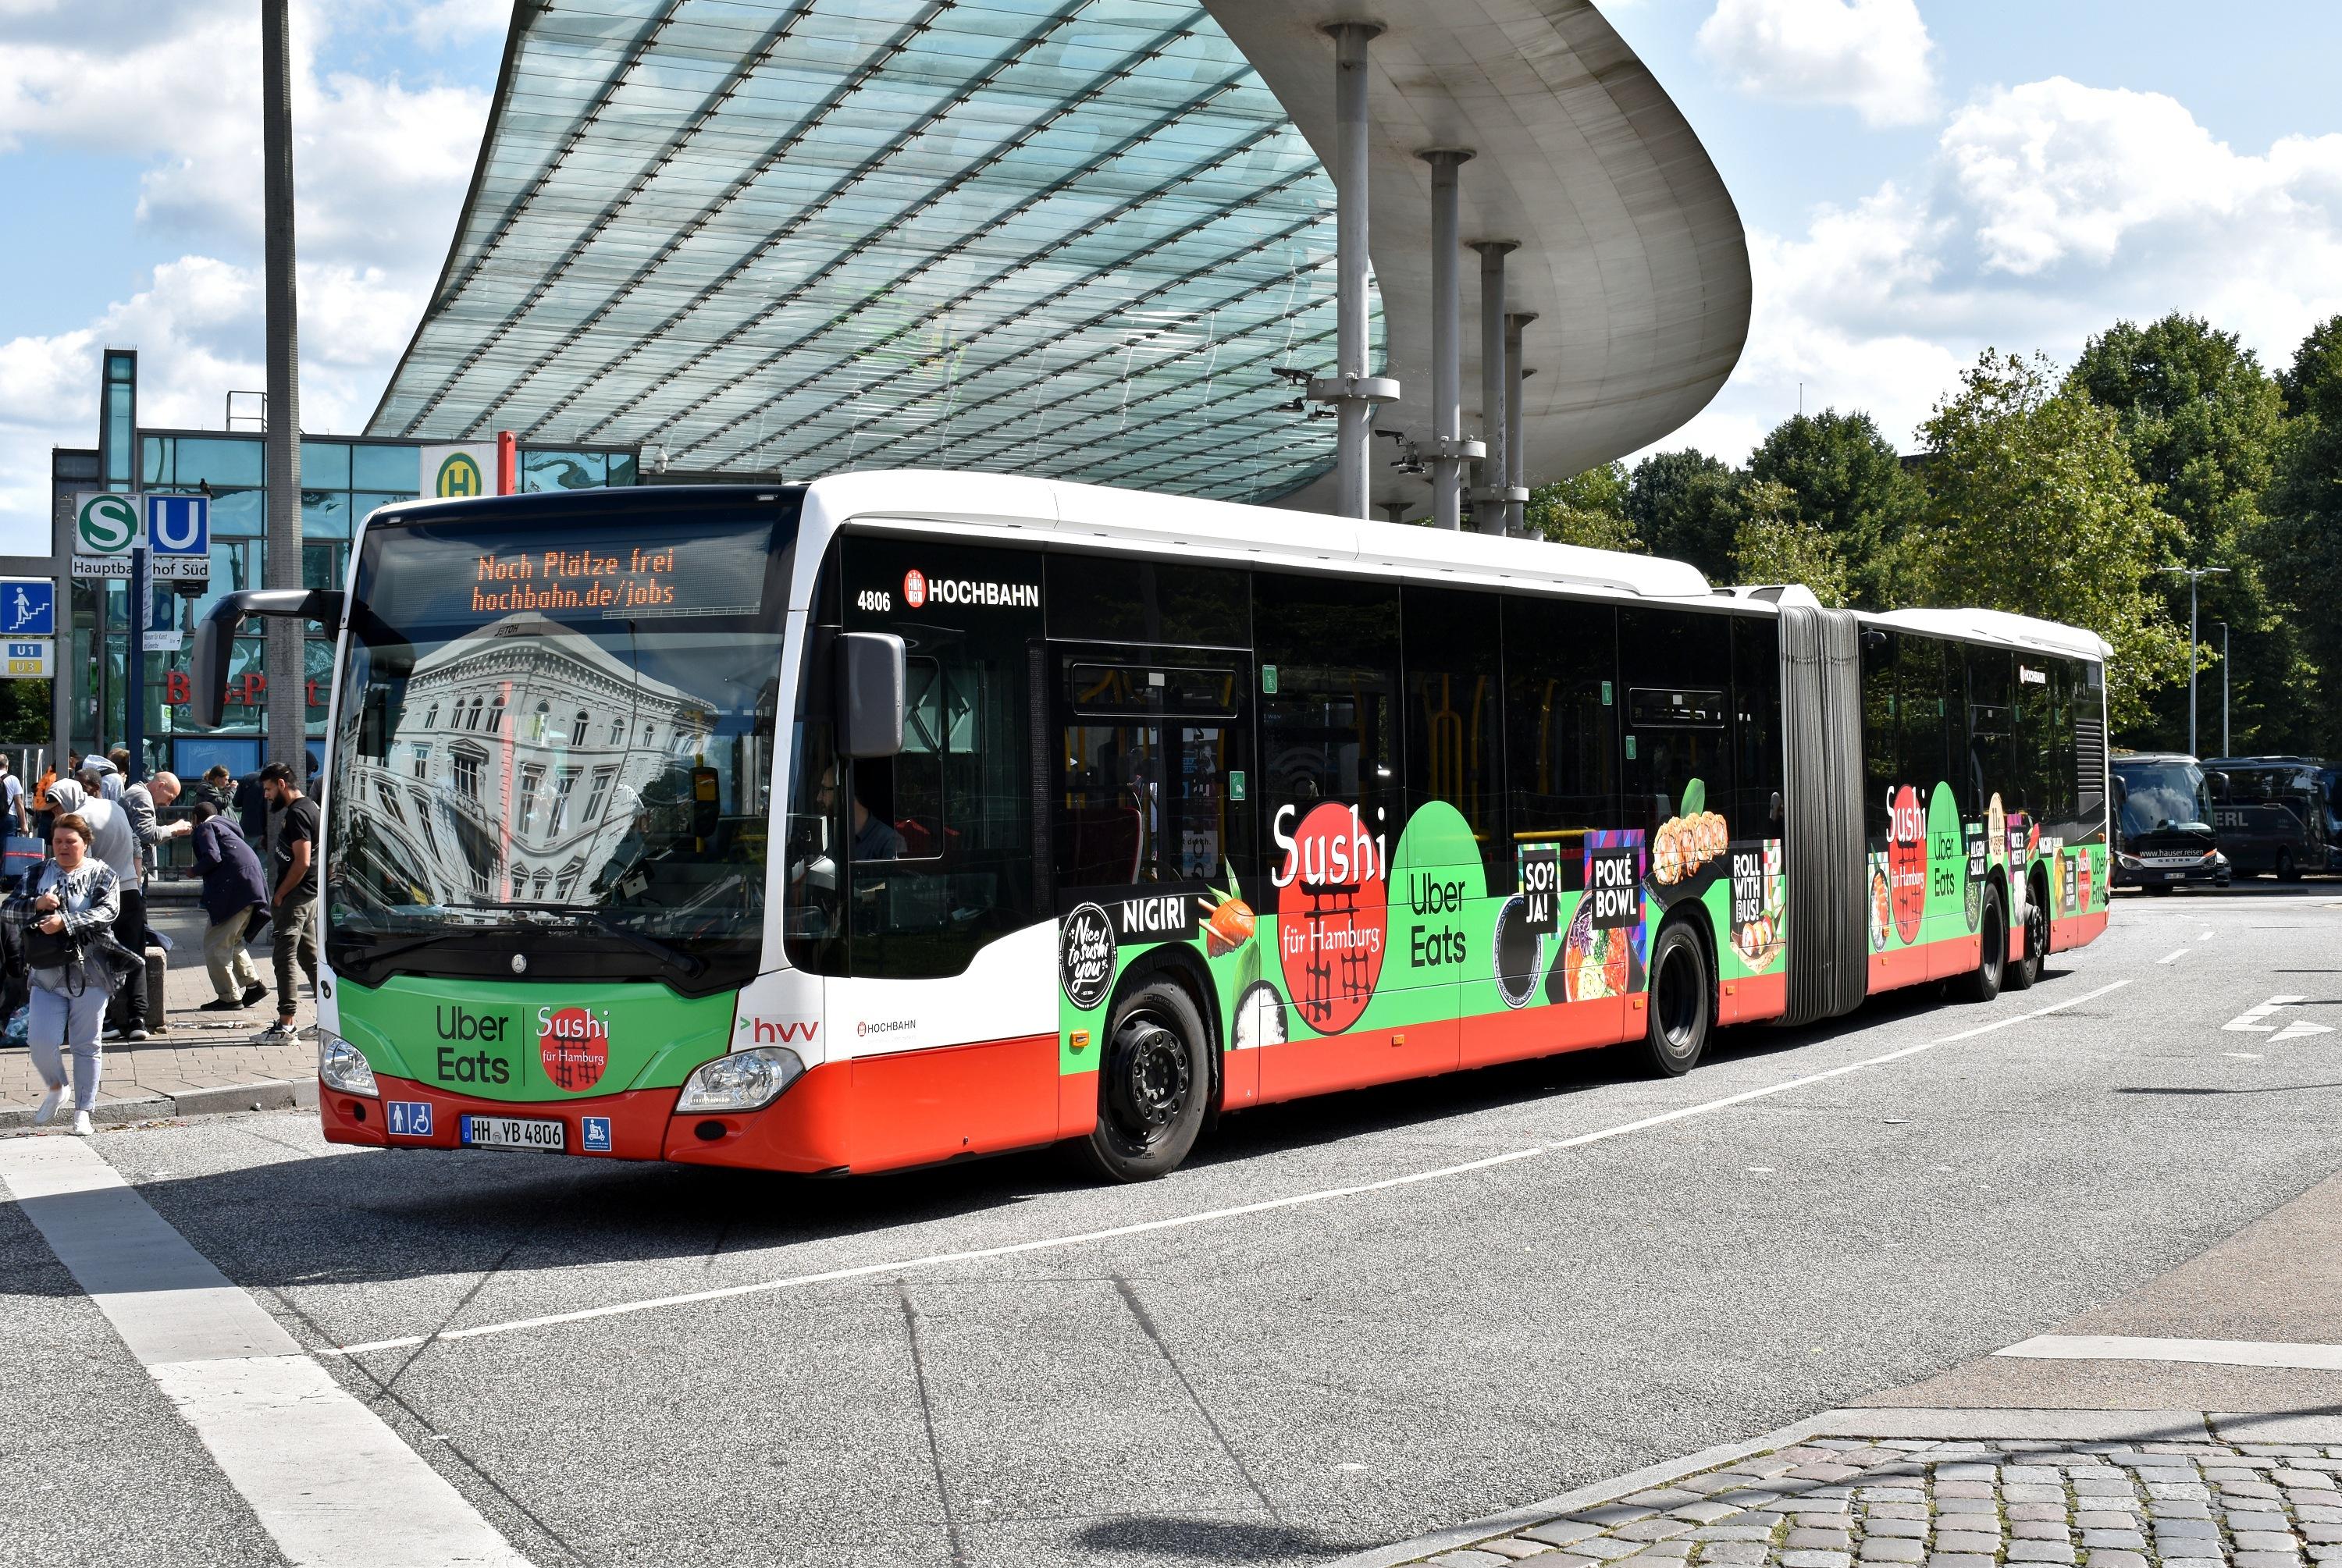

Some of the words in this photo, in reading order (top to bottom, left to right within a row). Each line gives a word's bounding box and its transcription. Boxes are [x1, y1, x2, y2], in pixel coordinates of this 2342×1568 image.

[89, 500, 129, 547] S
[157, 501, 199, 549] U
[74, 562, 175, 576] Hauptbahof
[182, 564, 208, 576] Süd
[478, 554, 532, 580] Noch
[544, 550, 618, 578] Plätze
[631, 548, 674, 574] frei
[472, 578, 674, 611] hochbahn.de/jobs
[858, 590, 891, 612] 4806
[928, 579, 1039, 606] HOCHBAHN
[1886, 785, 1926, 843] Sushi
[1271, 803, 1386, 887] Sushi
[1934, 831, 1954, 861] Uber
[1970, 841, 1985, 858] ALGEN
[2011, 849, 2021, 866] MEET
[2139, 848, 2204, 858] www.hauser.reisen
[1525, 861, 1555, 891] SO?
[1596, 853, 1632, 887] POKÉ
[1733, 853, 1761, 877] ROLL
[1899, 865, 1924, 889] Hamburg
[1970, 858, 1984, 876] SALAT
[1410, 872, 1465, 916] Uber
[1733, 876, 1760, 899] WITH
[1934, 868, 1955, 897] Eats
[1123, 897, 1186, 933] NIGIRI
[1525, 894, 1548, 923] JA!
[1596, 889, 1637, 918] BOWL
[1735, 898, 1760, 923] BUS!
[1074, 916, 1100, 945] Nice
[1283, 925, 1306, 962] für
[1309, 919, 1380, 952] Hamburg
[1068, 943, 1080, 967] to
[1080, 926, 1109, 961] sushi
[1411, 925, 1466, 968] Eats
[1072, 960, 1105, 994] you
[436, 1005, 509, 1042] Uber
[536, 1006, 610, 1039] Sushi
[867, 1019, 917, 1033] HOCHBAHN
[436, 1047, 510, 1084] Eats
[543, 1050, 556, 1063] für
[558, 1050, 604, 1065] Hamburg
[472, 1120, 491, 1141] HH
[502, 1122, 520, 1143] YB
[525, 1123, 561, 1146] 4806
